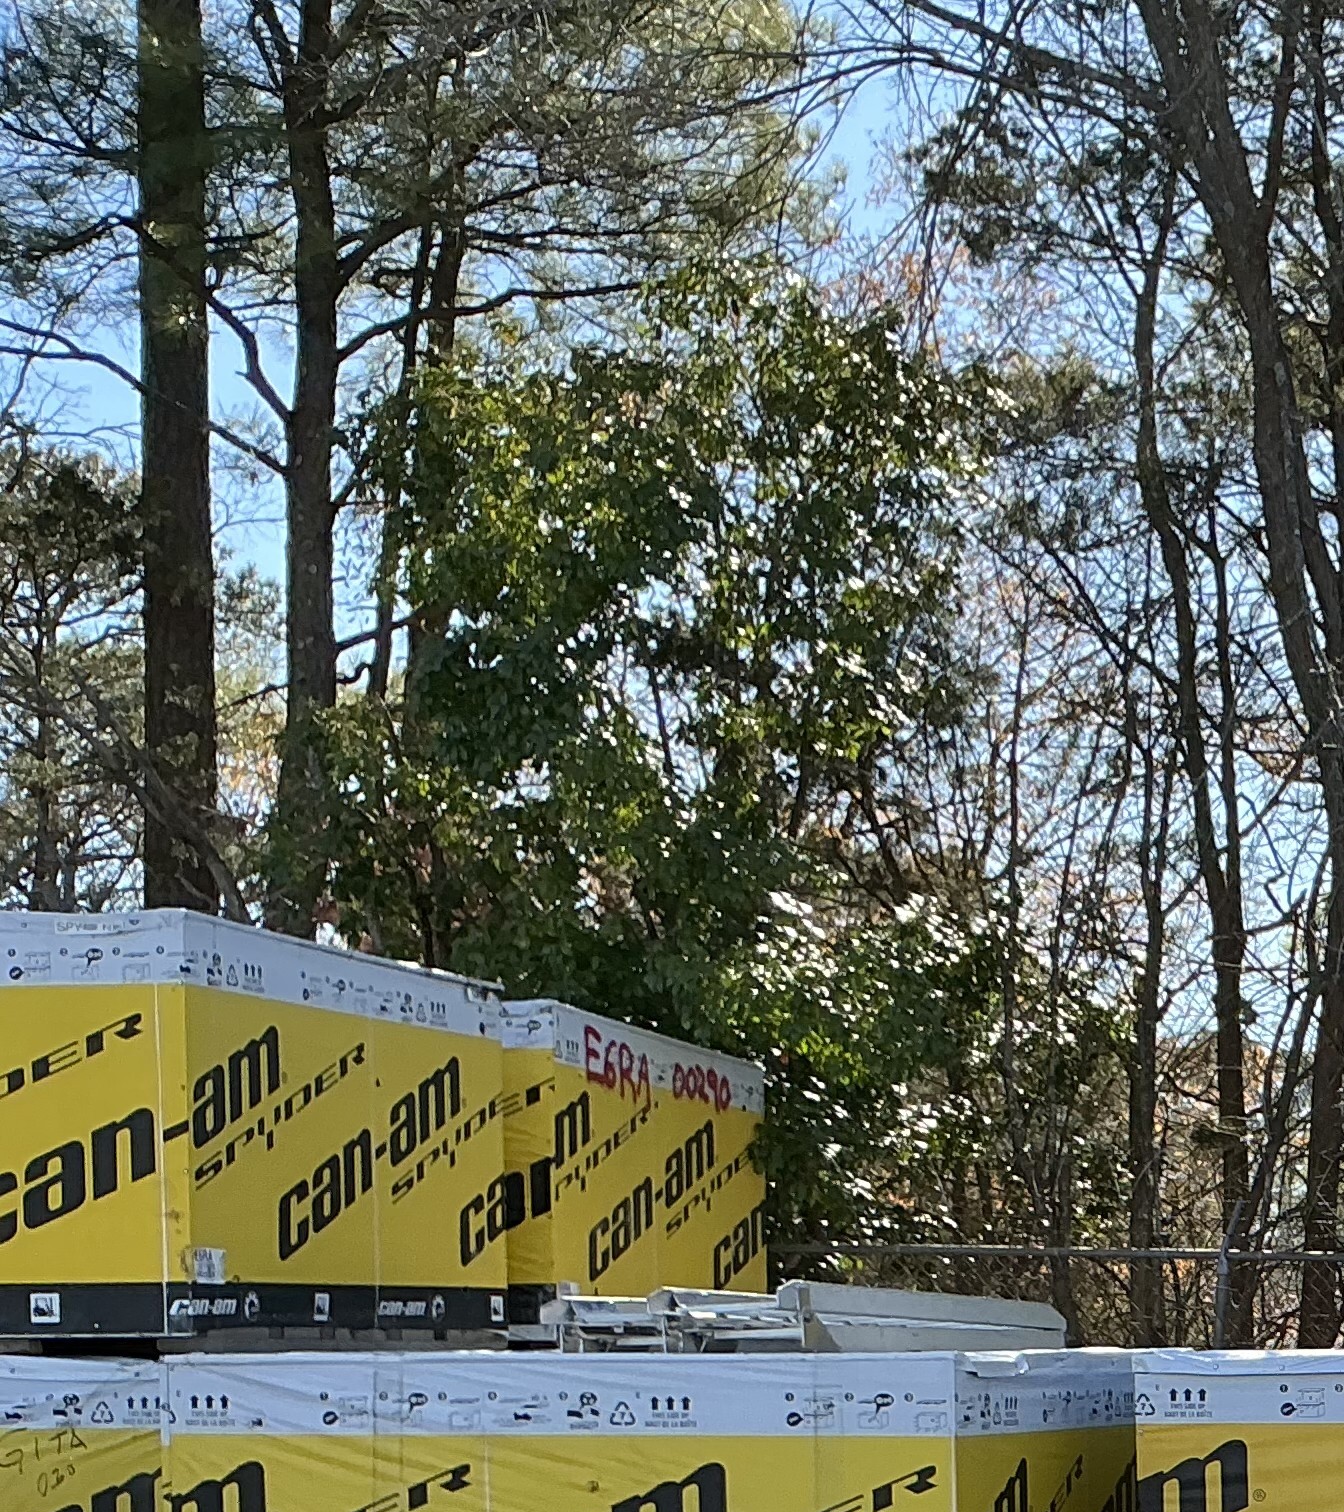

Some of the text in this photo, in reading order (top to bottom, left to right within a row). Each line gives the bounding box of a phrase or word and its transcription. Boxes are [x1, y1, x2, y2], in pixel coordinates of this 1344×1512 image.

[194, 1042, 366, 1191] SPYDER
[278, 1056, 461, 1261] can-am
[588, 1119, 715, 1282] can-am
[169, 1298, 237, 1316] can-am
[378, 1300, 427, 1317] can-am
